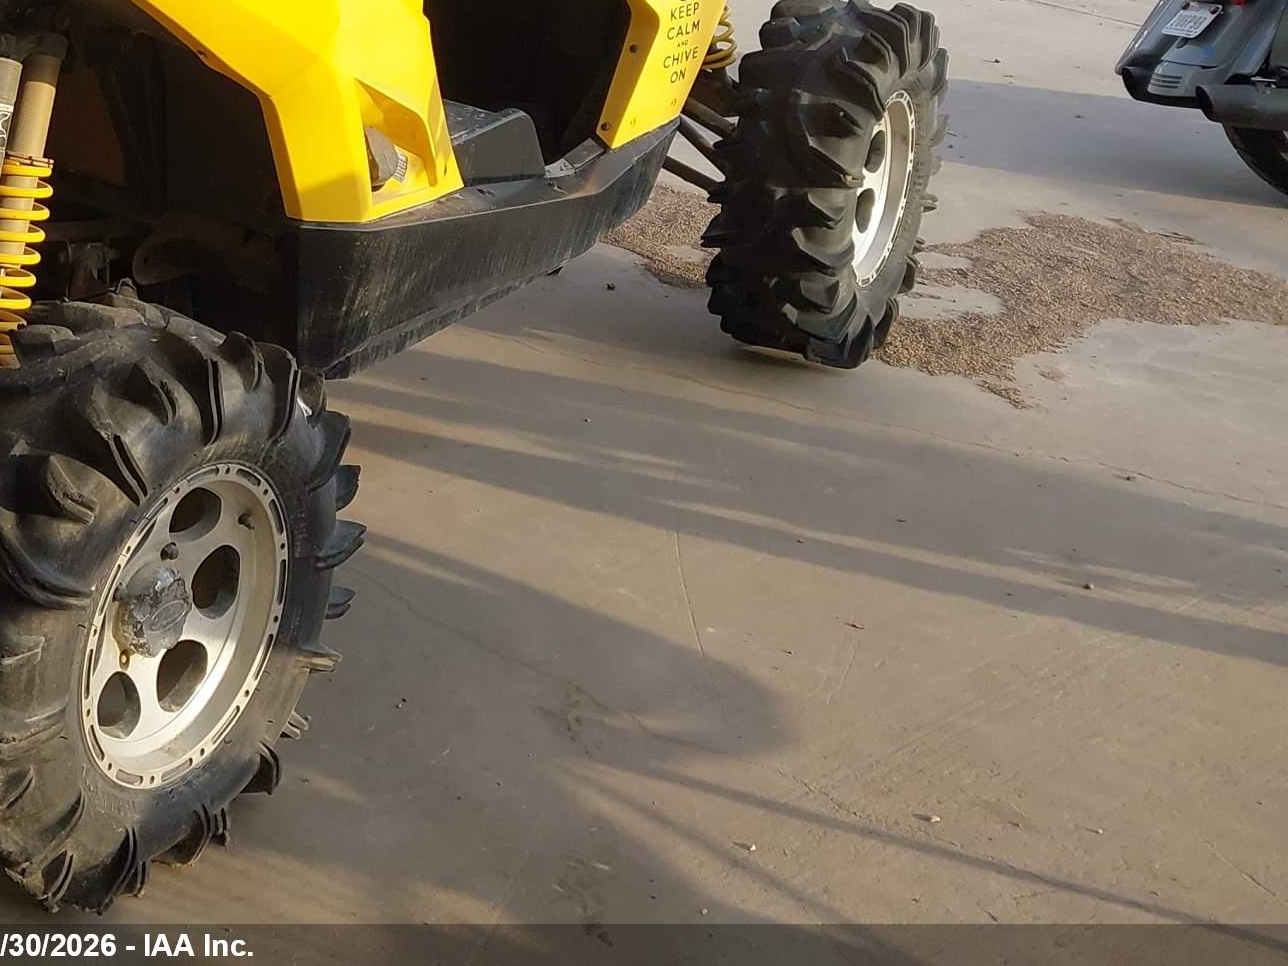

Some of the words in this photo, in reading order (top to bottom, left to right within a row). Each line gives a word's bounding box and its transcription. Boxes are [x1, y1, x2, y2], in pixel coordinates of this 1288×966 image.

[670, 1, 700, 21] KEEP
[666, 19, 700, 40] CALM
[677, 39, 689, 48] AND
[663, 46, 699, 69] CHIVE
[670, 67, 687, 84] ON
